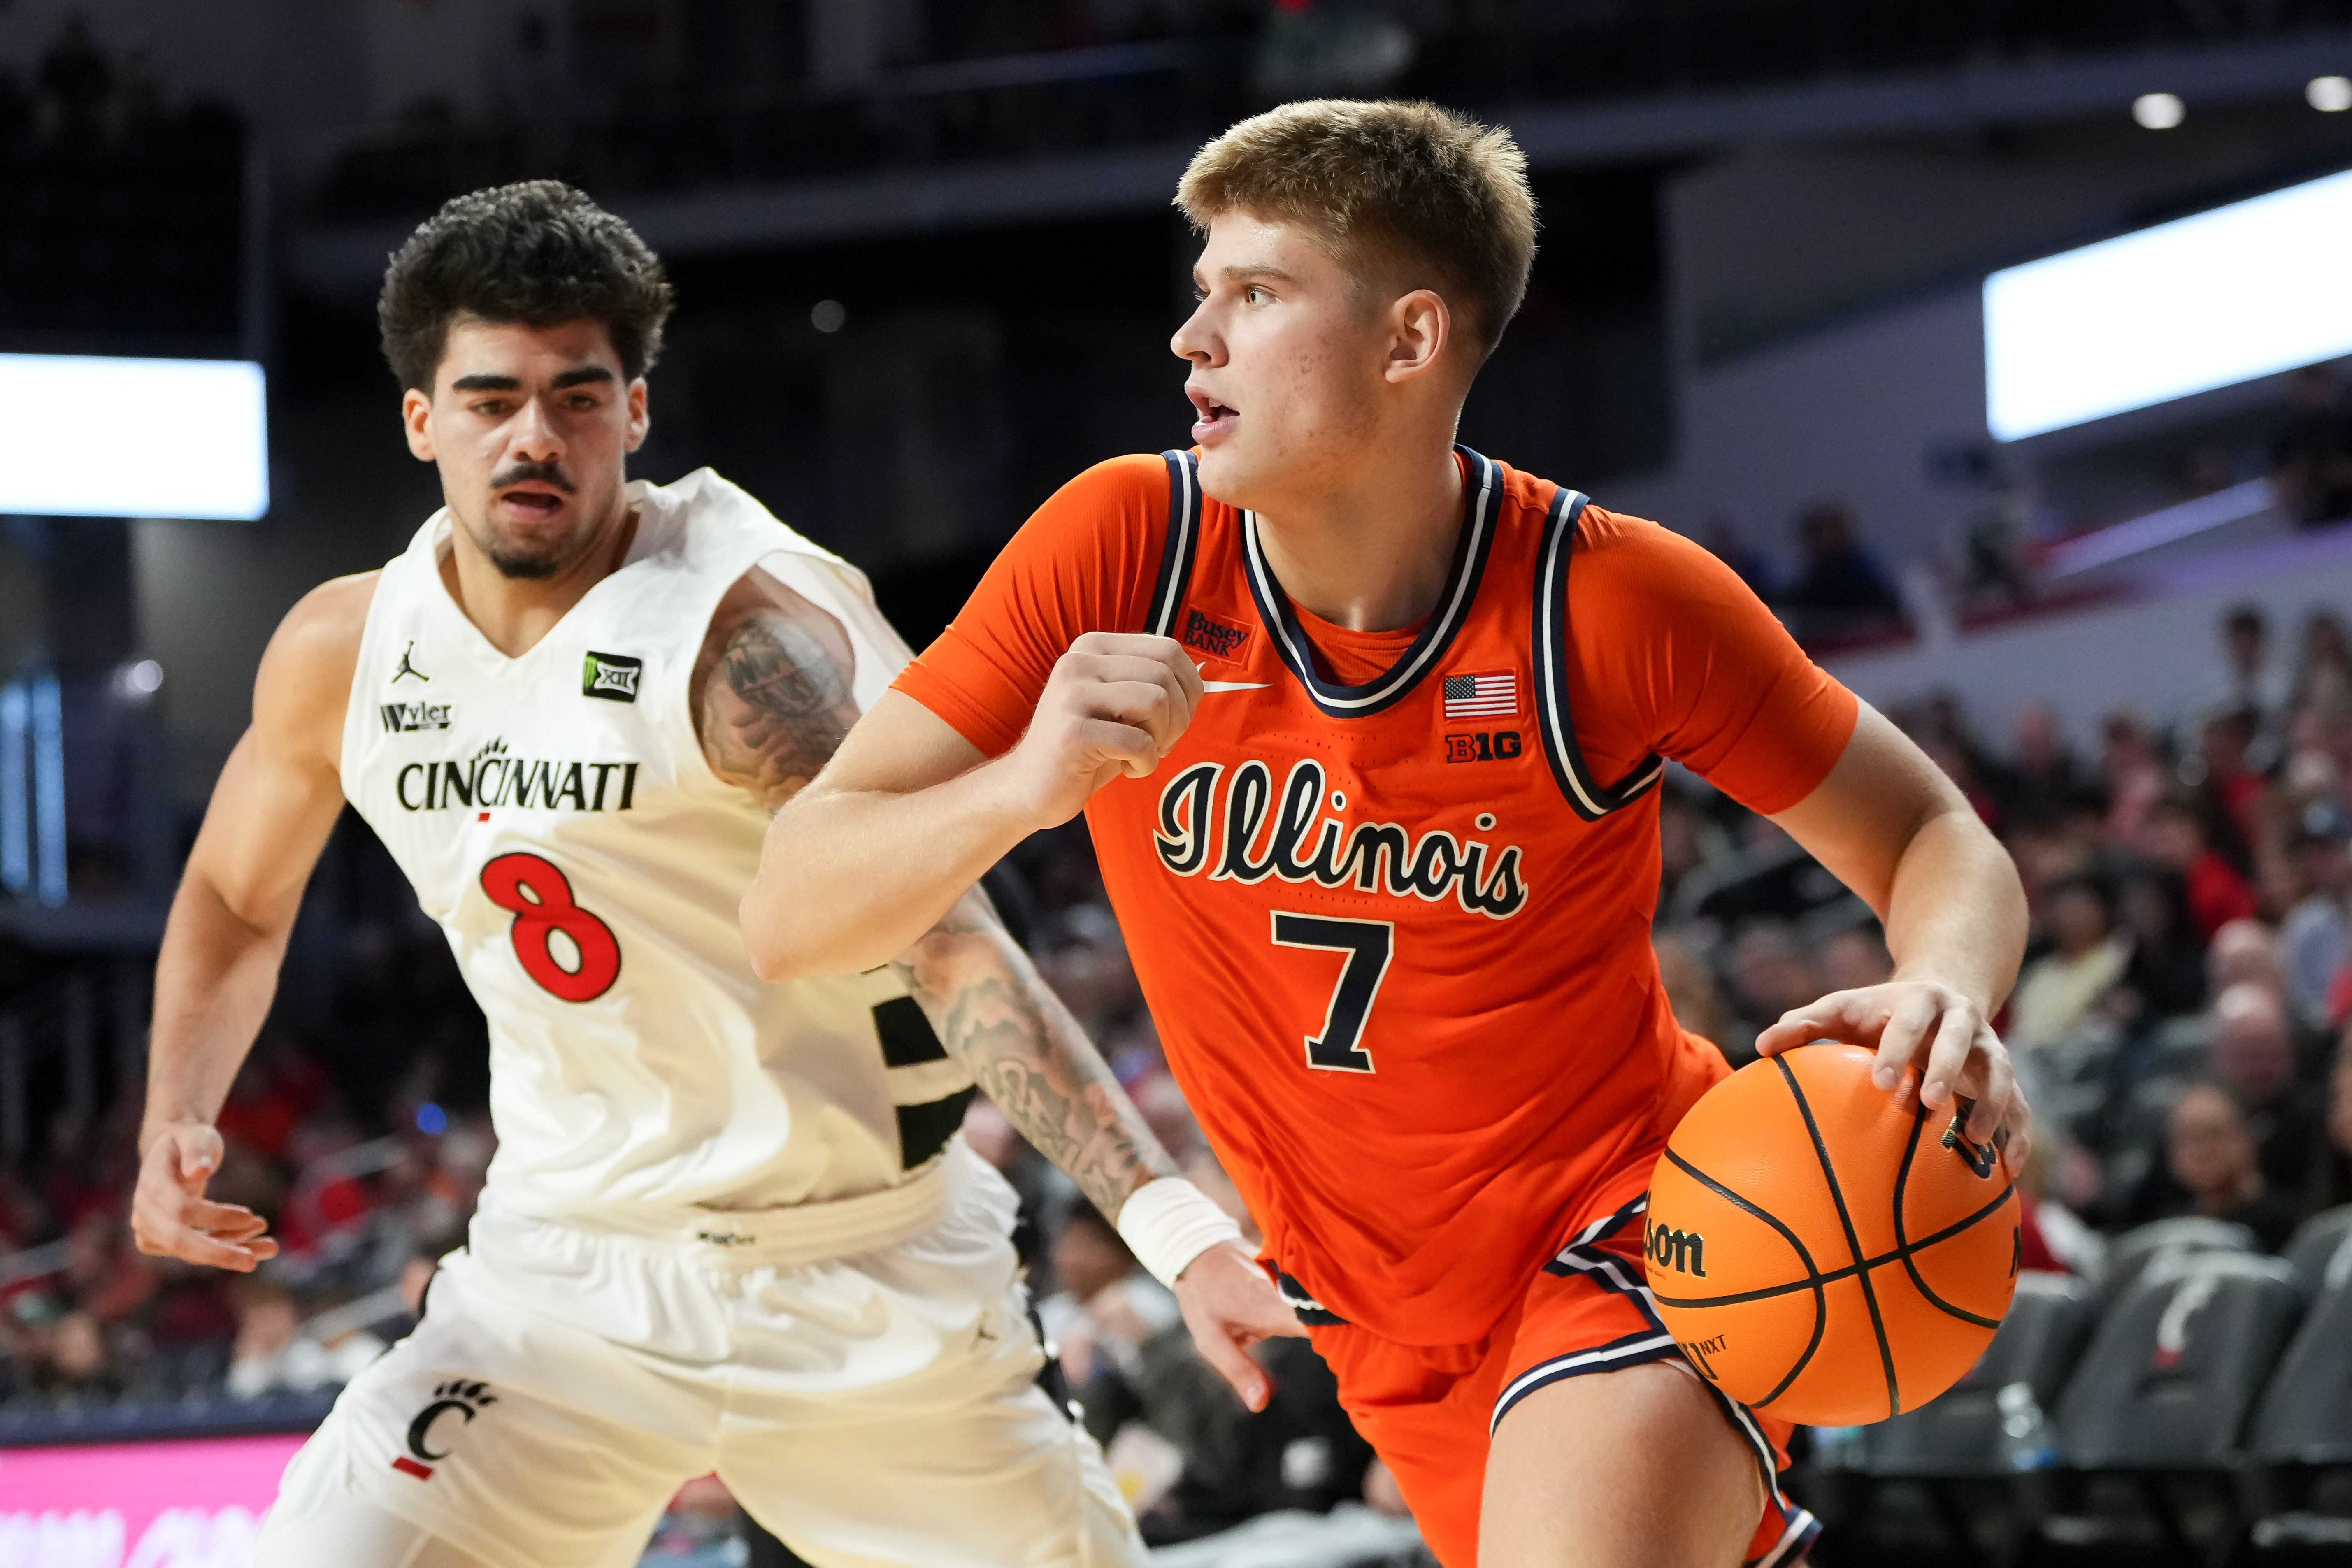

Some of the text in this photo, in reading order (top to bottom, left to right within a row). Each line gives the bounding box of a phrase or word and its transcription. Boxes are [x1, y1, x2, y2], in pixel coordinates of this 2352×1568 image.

[1183, 628, 1229, 657] BANK
[1188, 610, 1249, 649] Busey
[380, 701, 451, 732] Wyler
[396, 757, 639, 811] CINCINNATI
[1153, 758, 1529, 920] Illinois
[480, 852, 621, 1003] 8
[1270, 909, 1395, 1074] 7
[1699, 1334, 1726, 1355] NXT
